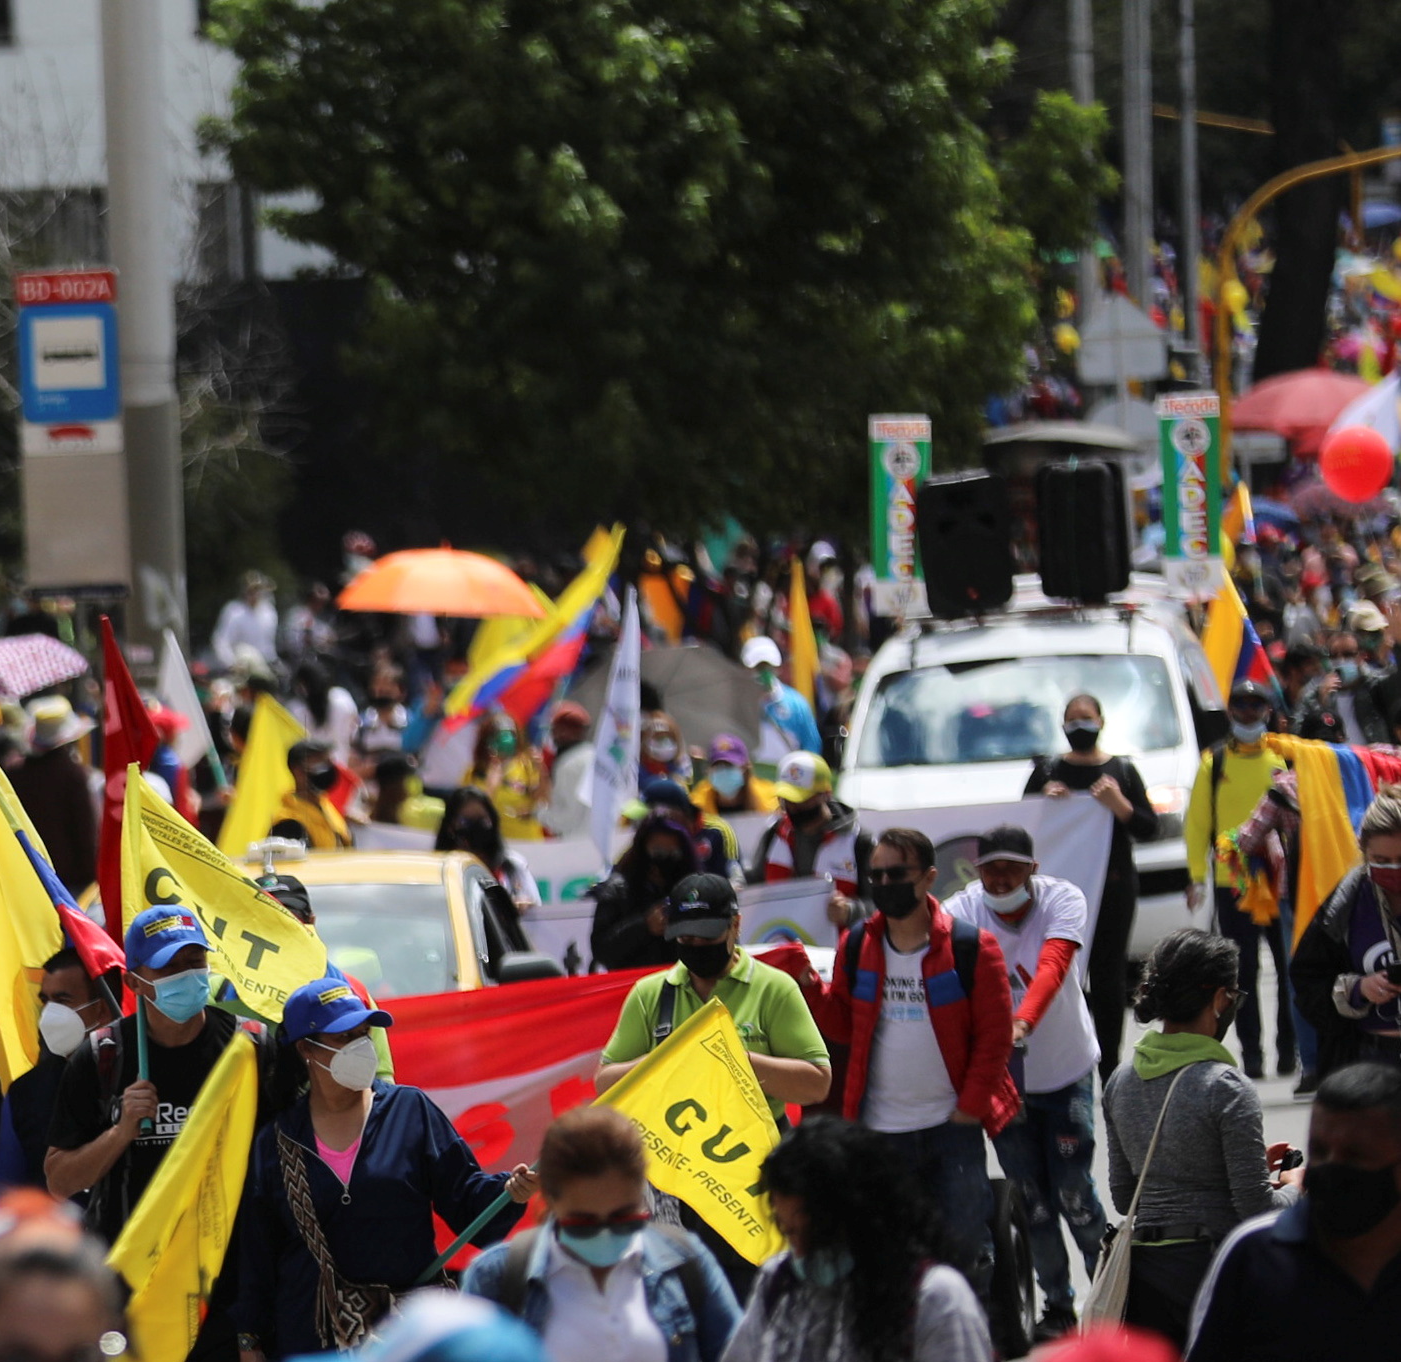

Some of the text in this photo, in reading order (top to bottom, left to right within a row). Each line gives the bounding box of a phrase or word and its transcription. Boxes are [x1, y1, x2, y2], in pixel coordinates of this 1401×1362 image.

[23, 279, 112, 301] BD-002A
[217, 945, 288, 1005] PRESENTE
[693, 1169, 764, 1239] PRESENTE
